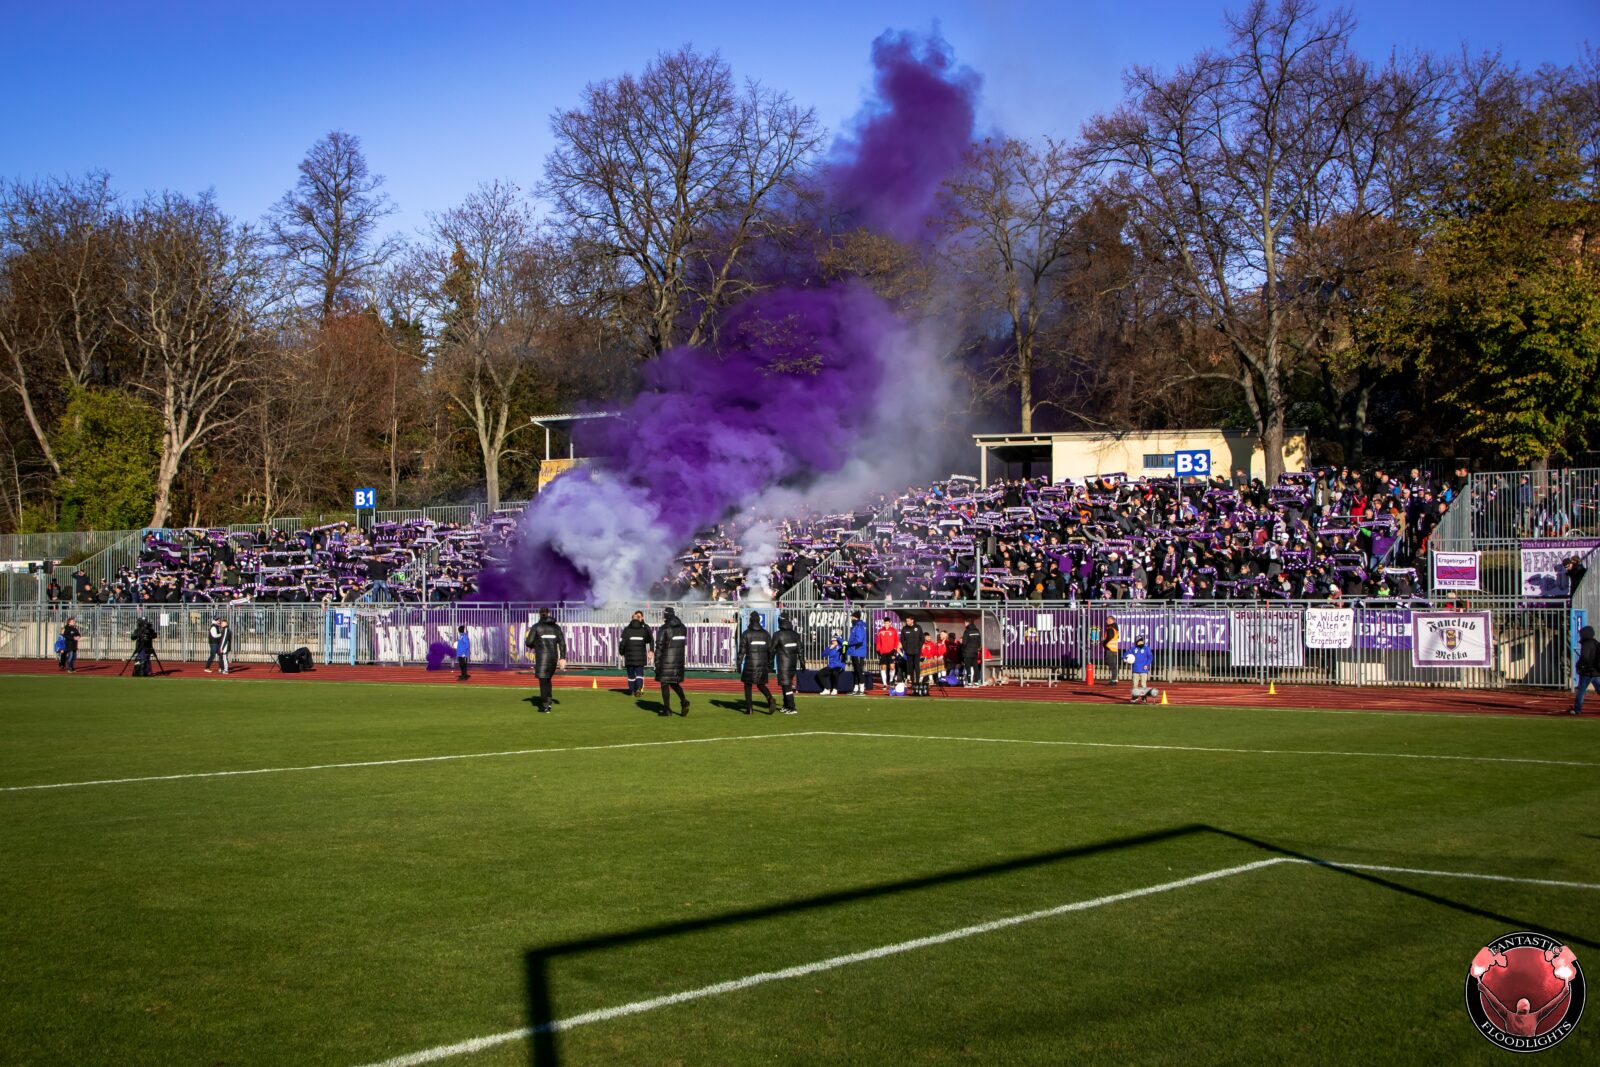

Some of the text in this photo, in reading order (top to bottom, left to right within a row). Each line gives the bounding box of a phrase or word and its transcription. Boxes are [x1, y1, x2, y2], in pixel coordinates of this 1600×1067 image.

[1177, 453, 1208, 472] B3
[1320, 611, 1351, 622] Wilden
[1316, 621, 1339, 630] Alten
[1426, 618, 1476, 633] Fanclub
[1311, 636, 1348, 648] Erzgebirge
[1435, 649, 1468, 660] Mekka
